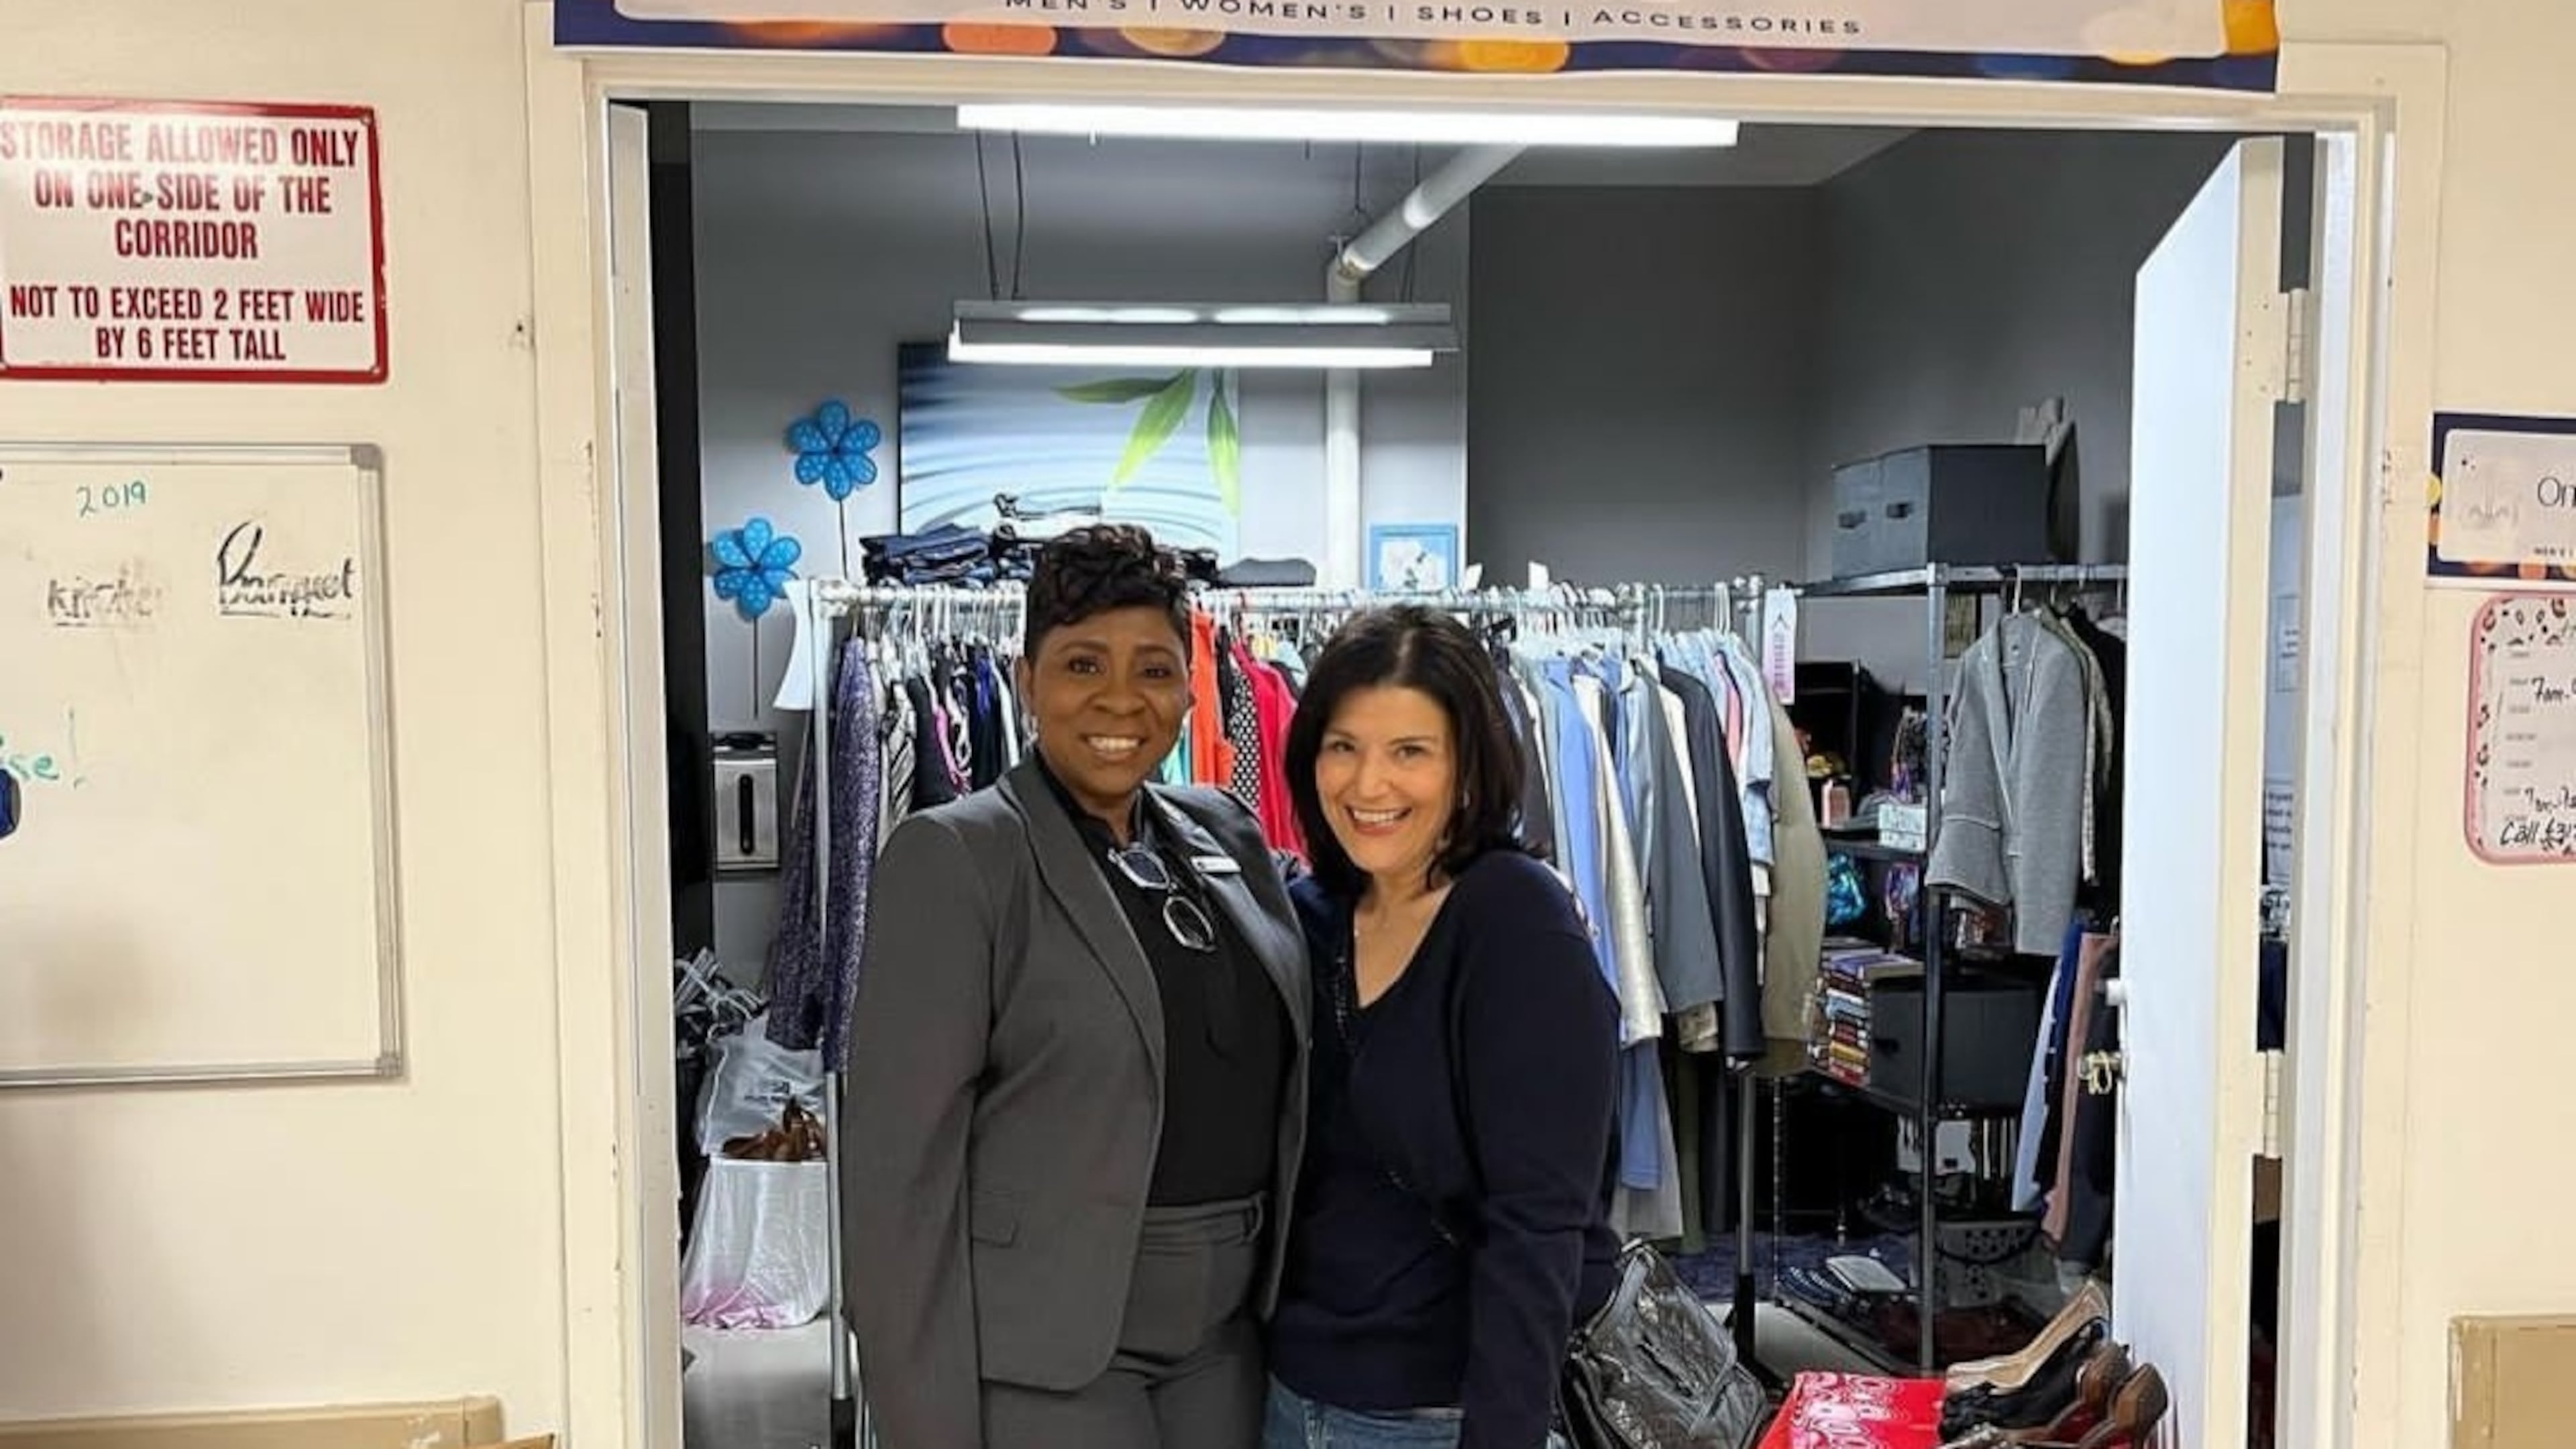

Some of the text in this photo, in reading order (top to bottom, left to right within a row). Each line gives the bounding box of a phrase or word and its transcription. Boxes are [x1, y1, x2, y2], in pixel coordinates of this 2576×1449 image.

[1182, 0, 1366, 19] WOMEN'S
[1417, 6, 1542, 24] SHOES
[1593, 10, 1861, 34] ACCESSORIES
[0, 121, 358, 167] STORAGE ALLOWED ONLY
[35, 170, 331, 213] ON ONE SIDE OF THE
[115, 220, 258, 259] CORRIDOR
[11, 286, 364, 322] NOT TO EXCEED 2 FEET WIDE
[97, 327, 286, 361] BY 6 FEET TALL
[76, 481, 147, 517] 2019
